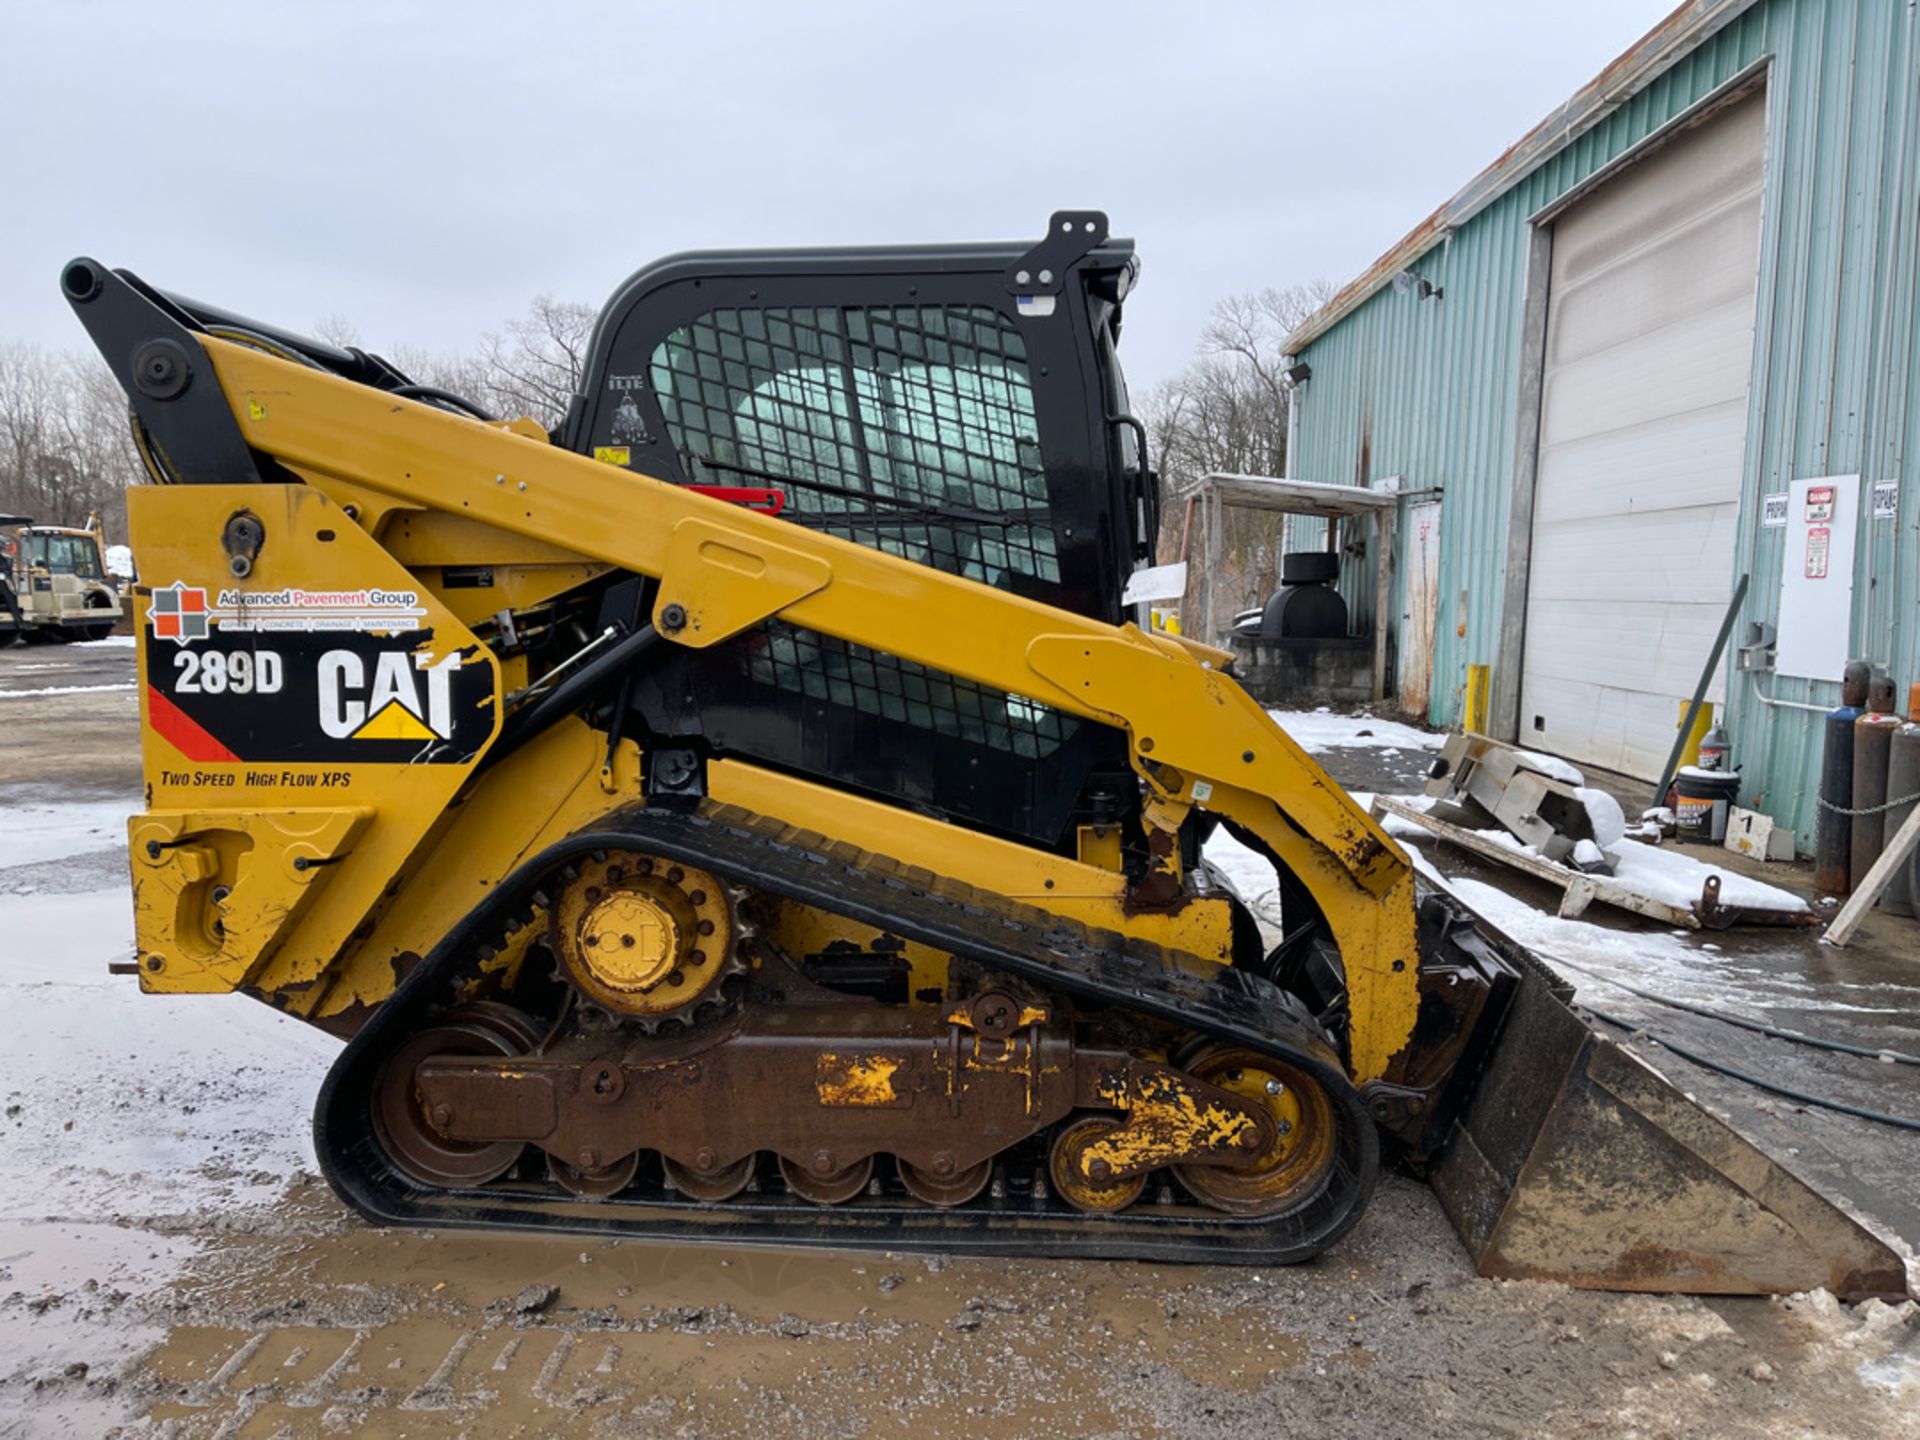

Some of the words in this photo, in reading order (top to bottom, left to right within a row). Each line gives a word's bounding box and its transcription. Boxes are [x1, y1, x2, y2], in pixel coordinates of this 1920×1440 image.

[219, 591, 290, 606] Advanced
[294, 590, 367, 605] Pavement
[371, 590, 416, 608] Group
[362, 618, 416, 628] MAINTENANCE
[173, 649, 283, 695] 289D
[316, 648, 462, 739] CAT
[320, 771, 352, 788] XPS
[1740, 815, 1753, 834] 1
